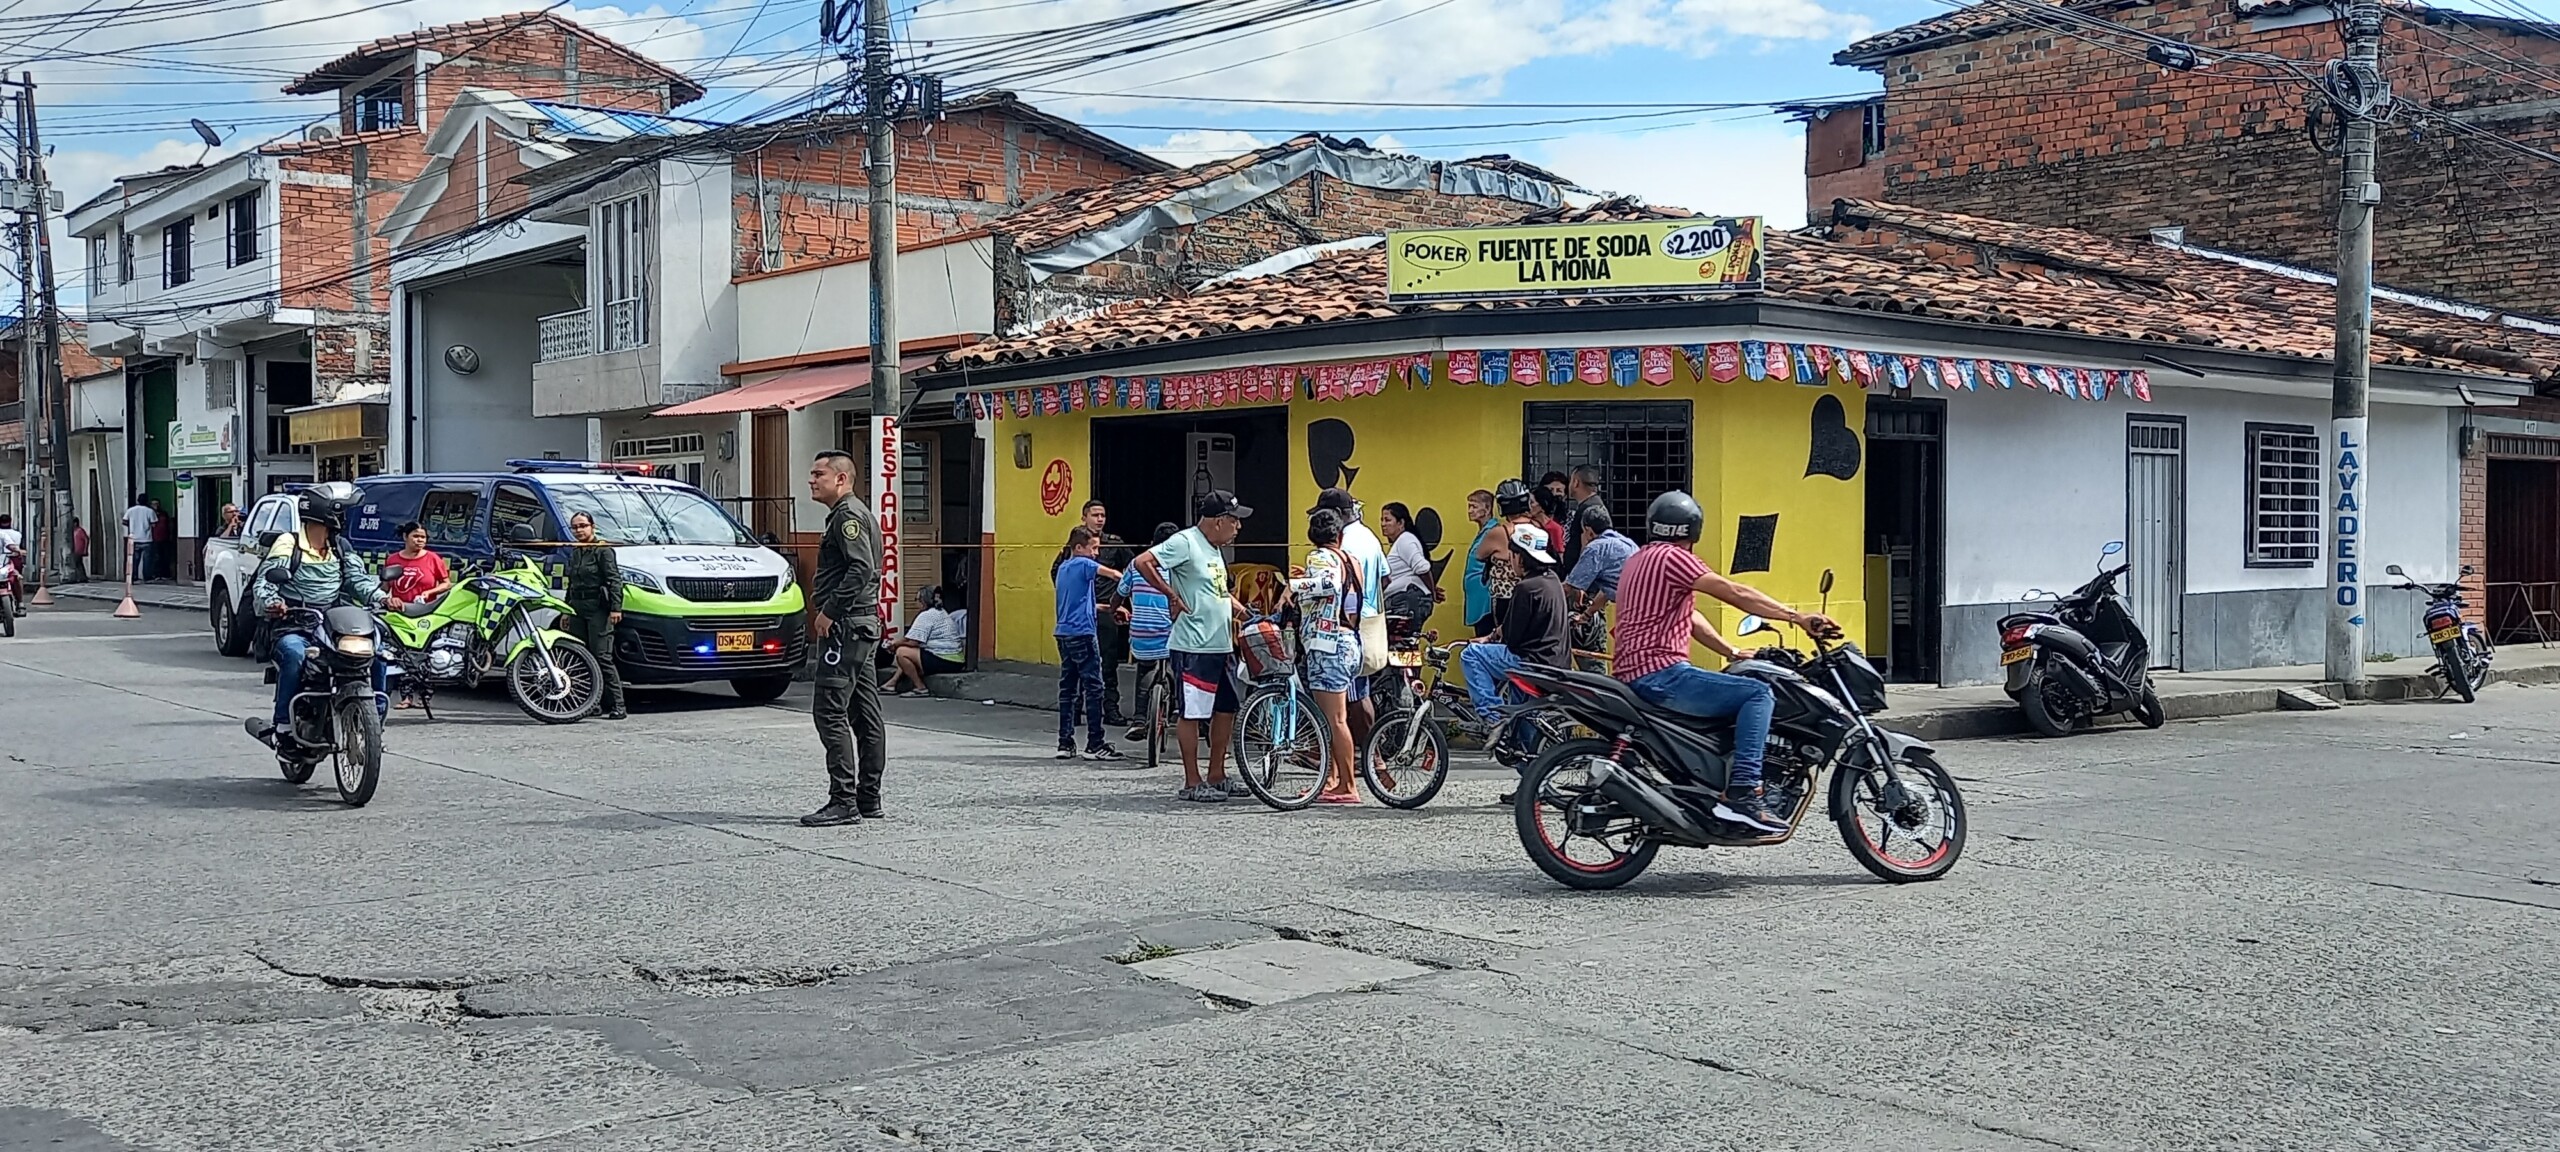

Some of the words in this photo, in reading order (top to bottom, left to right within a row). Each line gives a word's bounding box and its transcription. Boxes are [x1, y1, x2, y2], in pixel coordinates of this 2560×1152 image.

[1404, 243, 1467, 262] POKER
[1479, 238, 1557, 262] FUENTE
[1564, 237, 1591, 258] DE
[1596, 235, 1651, 257] SODA
[1667, 228, 1723, 254] $2.200
[1519, 261, 1546, 282] LA
[1552, 258, 1611, 281] MONA
[586, 483, 674, 494] POLICÍA
[2337, 431, 2359, 606] LAVADERO
[664, 554, 758, 563] POLICÍA
